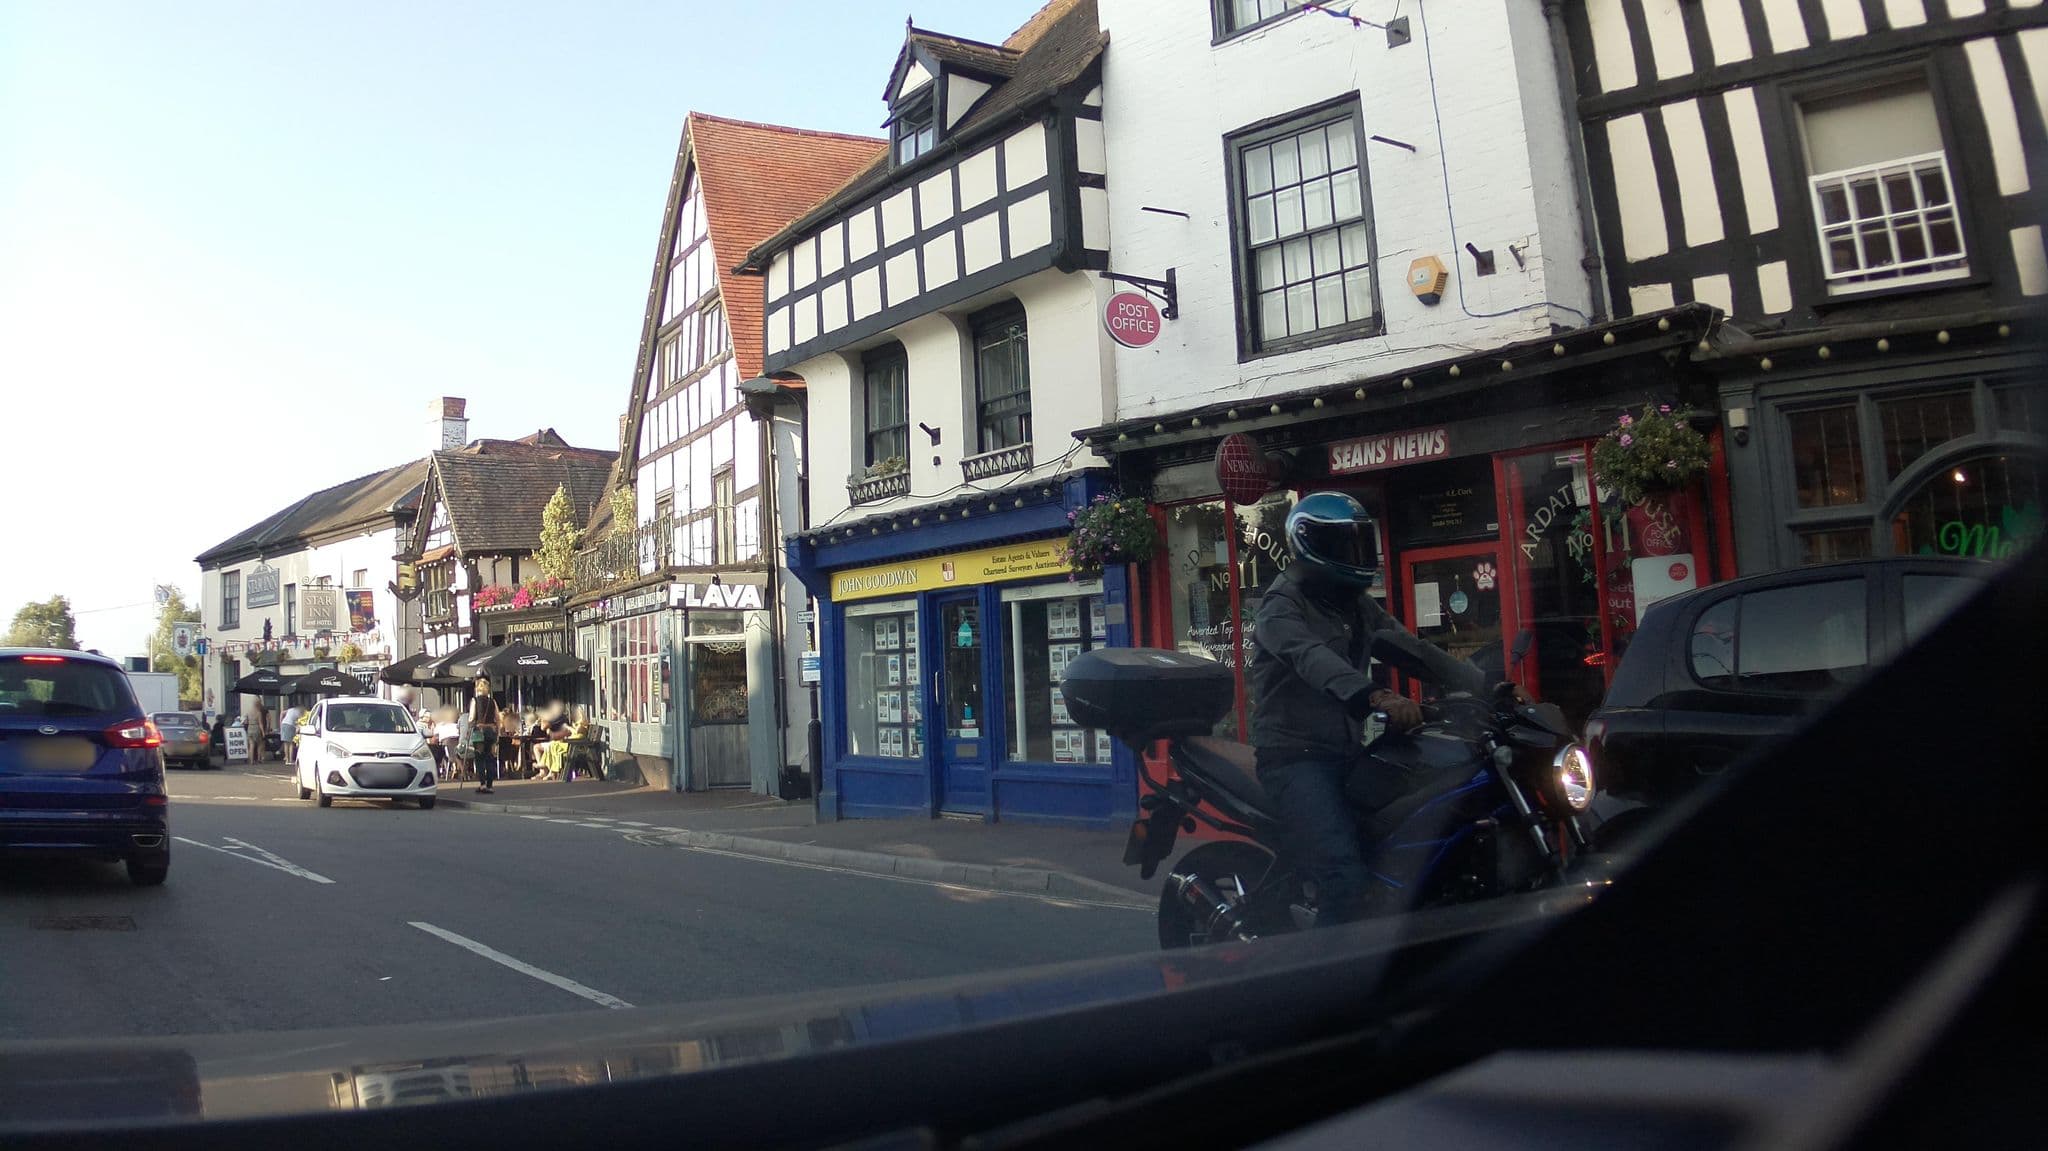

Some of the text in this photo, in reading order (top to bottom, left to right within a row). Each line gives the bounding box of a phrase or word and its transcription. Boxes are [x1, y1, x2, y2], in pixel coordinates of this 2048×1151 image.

[1119, 302, 1149, 318] POST
[1112, 316, 1155, 334] OFFICE
[1393, 429, 1445, 461] NEWS
[1603, 512, 1632, 553] 11
[1238, 555, 1259, 589] 11
[838, 568, 918, 596] JOHN GOODWIN
[305, 595, 333, 606] STAR
[669, 583, 762, 609] FLAVA
[309, 607, 330, 618] INN
[544, 620, 554, 630] INN
[229, 731, 243, 739] BAR
[229, 739, 245, 747] NOW
[229, 747, 248, 756] OPEN
